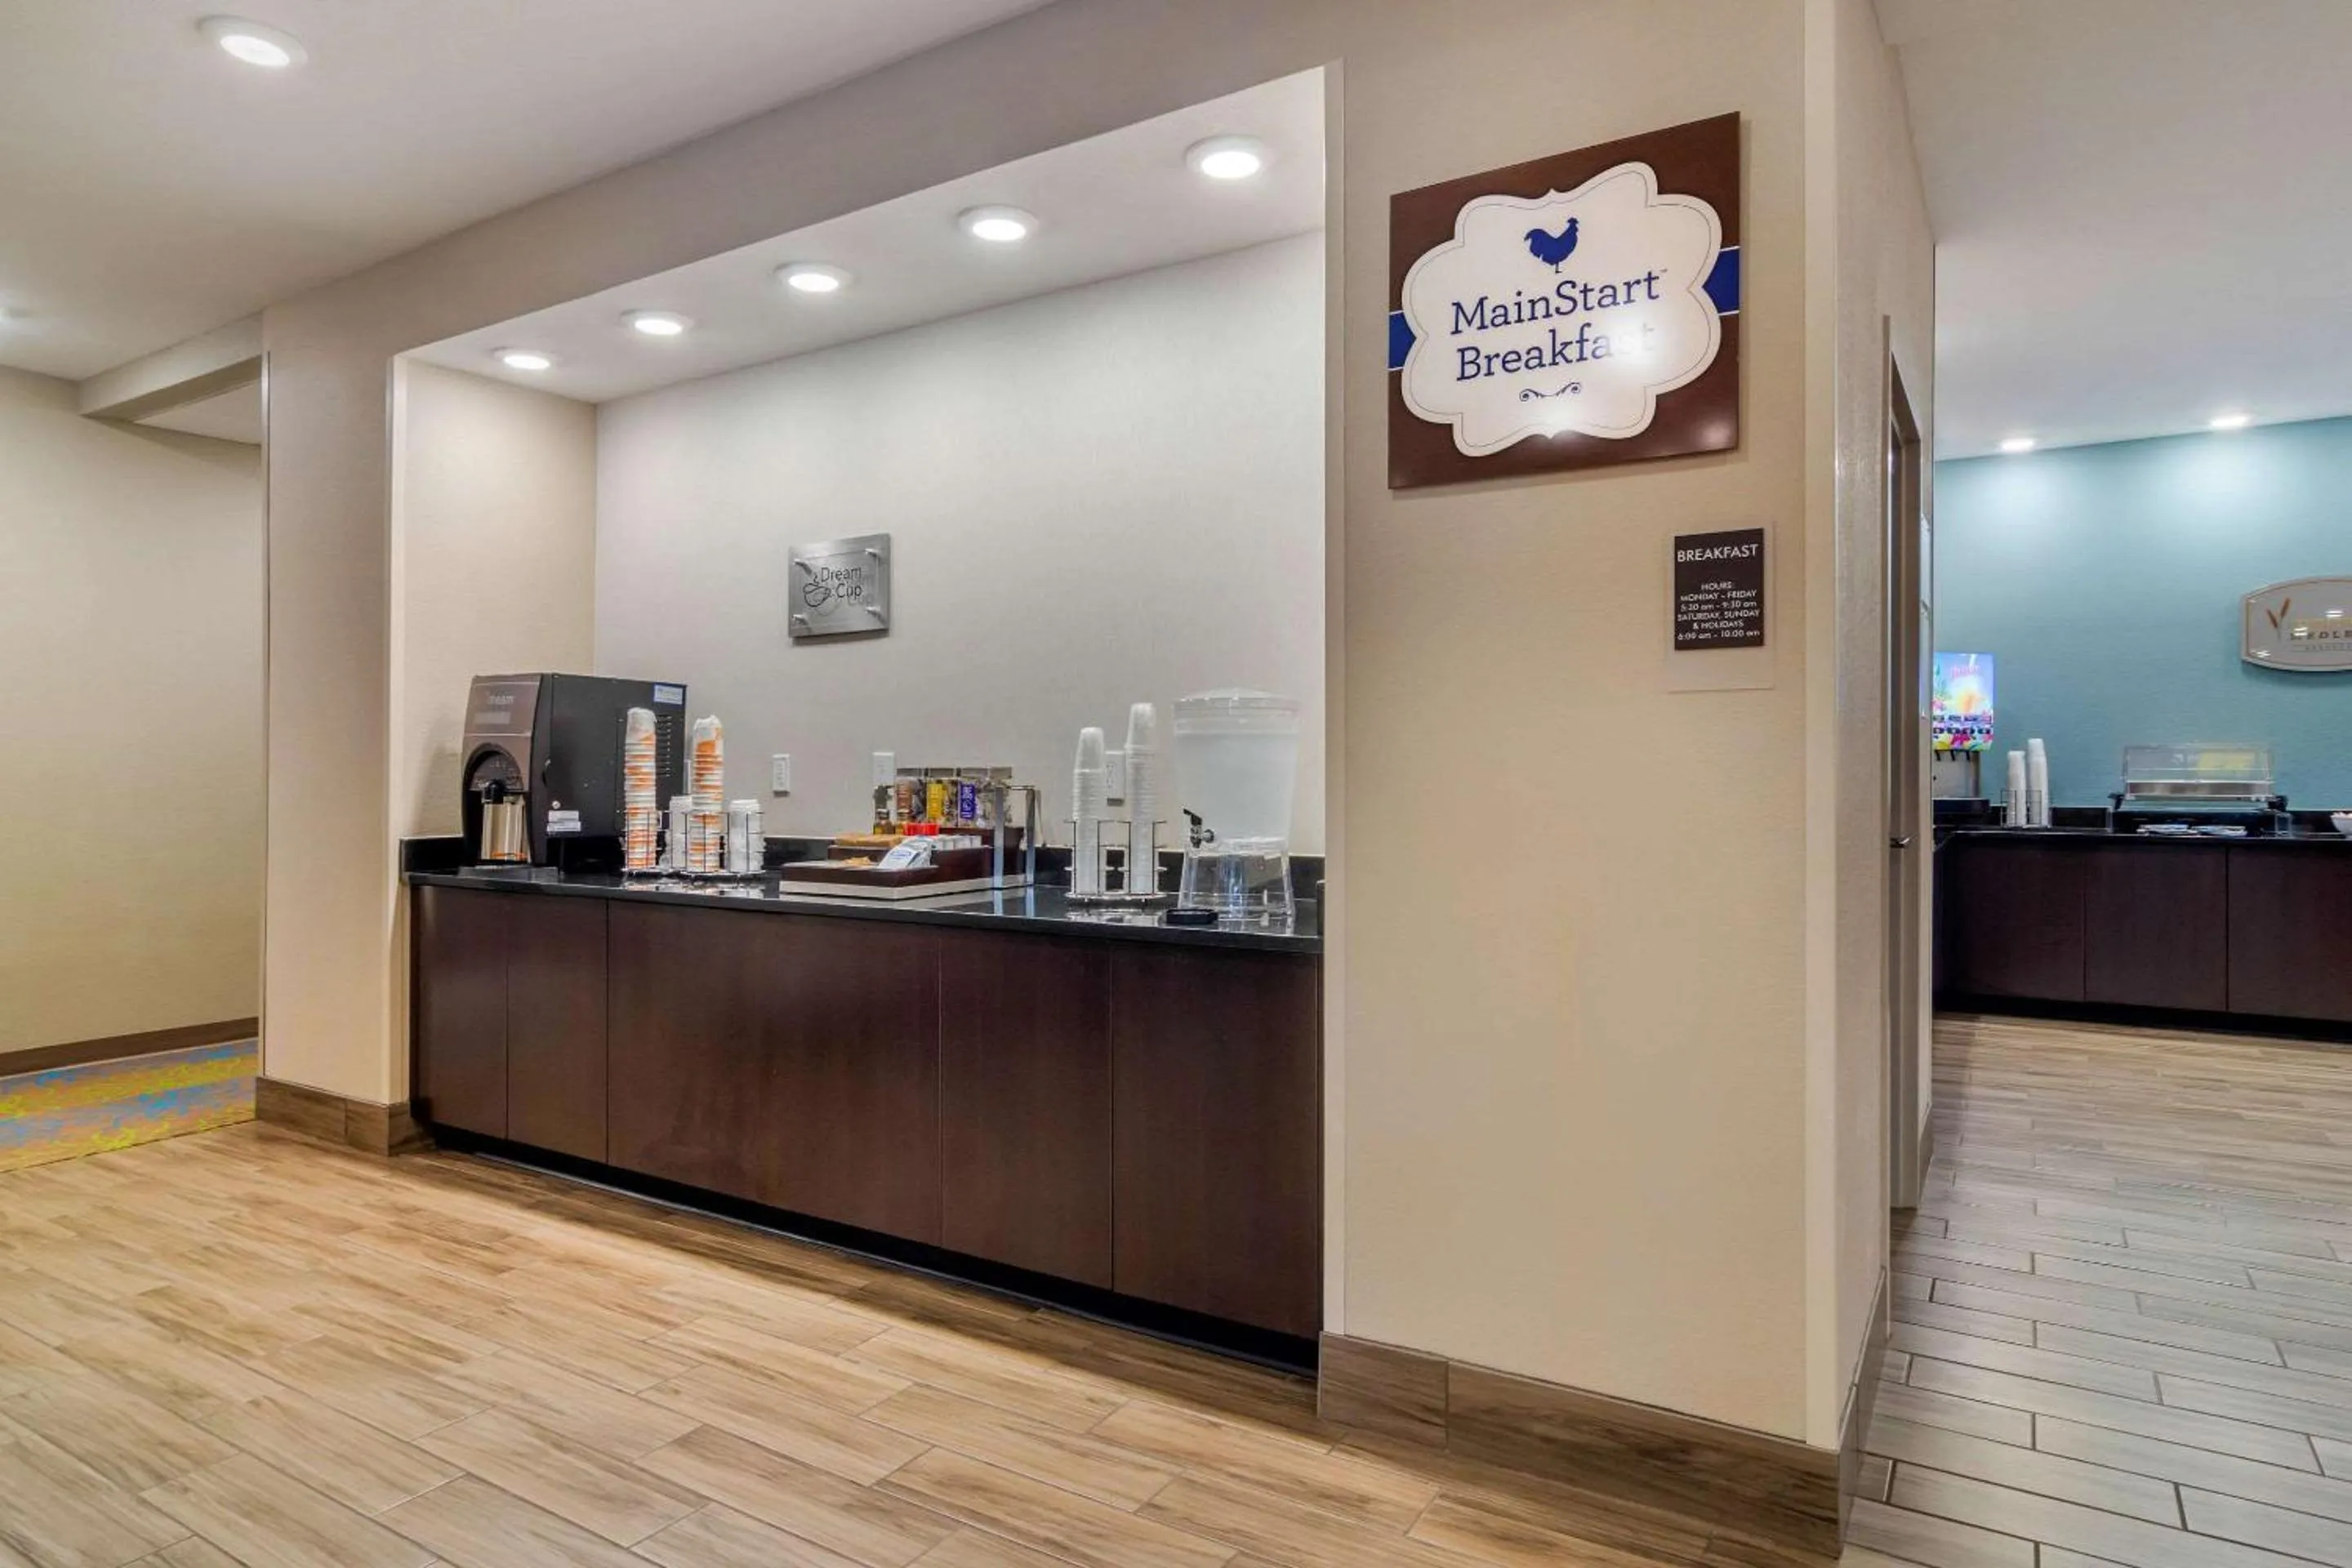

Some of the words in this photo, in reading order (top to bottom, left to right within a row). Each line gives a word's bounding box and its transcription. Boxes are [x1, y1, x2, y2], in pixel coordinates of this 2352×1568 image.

[1450, 270, 1659, 335] MainStart
[1456, 323, 1655, 381] Breakfa
[1677, 544, 1759, 562] BREAKFAST
[821, 567, 862, 582] Dream
[835, 582, 863, 600] Cup
[1680, 592, 1719, 601] MONDAY
[1727, 589, 1757, 599] FRIDAY
[1724, 609, 1760, 618] SUNDAY
[1693, 621, 1699, 630] &
[1701, 620, 1744, 630] HOLIDAYS
